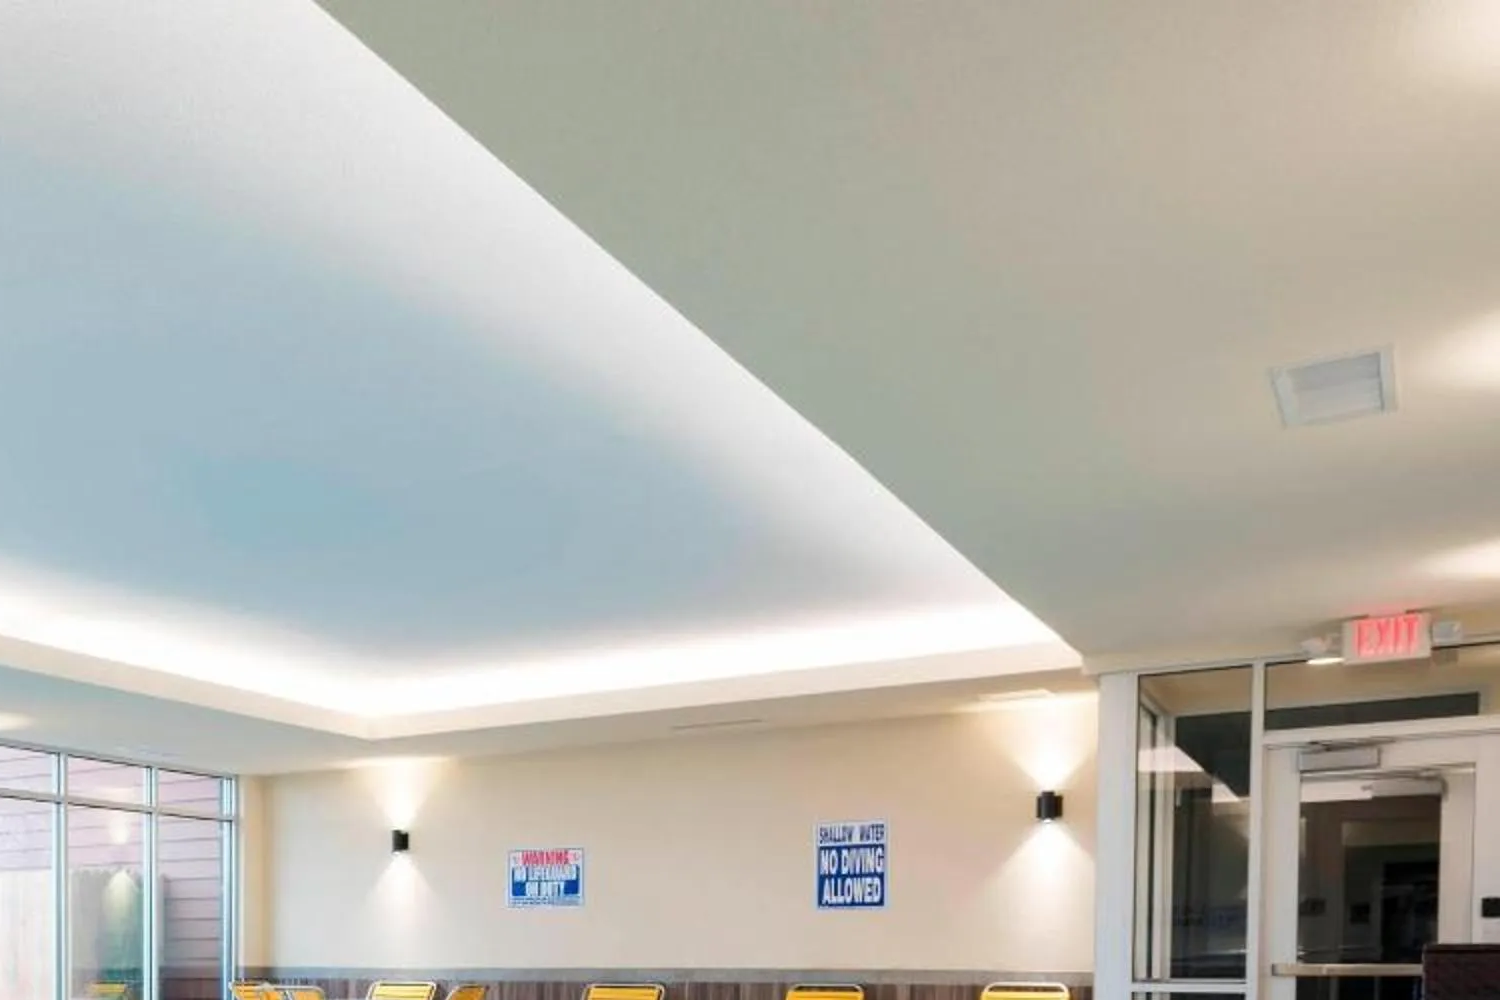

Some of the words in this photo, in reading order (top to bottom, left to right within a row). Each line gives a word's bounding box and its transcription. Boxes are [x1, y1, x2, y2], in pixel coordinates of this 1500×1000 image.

[1357, 615, 1419, 658] EXIT
[820, 849, 838, 875] NO
[841, 847, 885, 875] DIVING
[821, 877, 882, 905] ALLOWED
